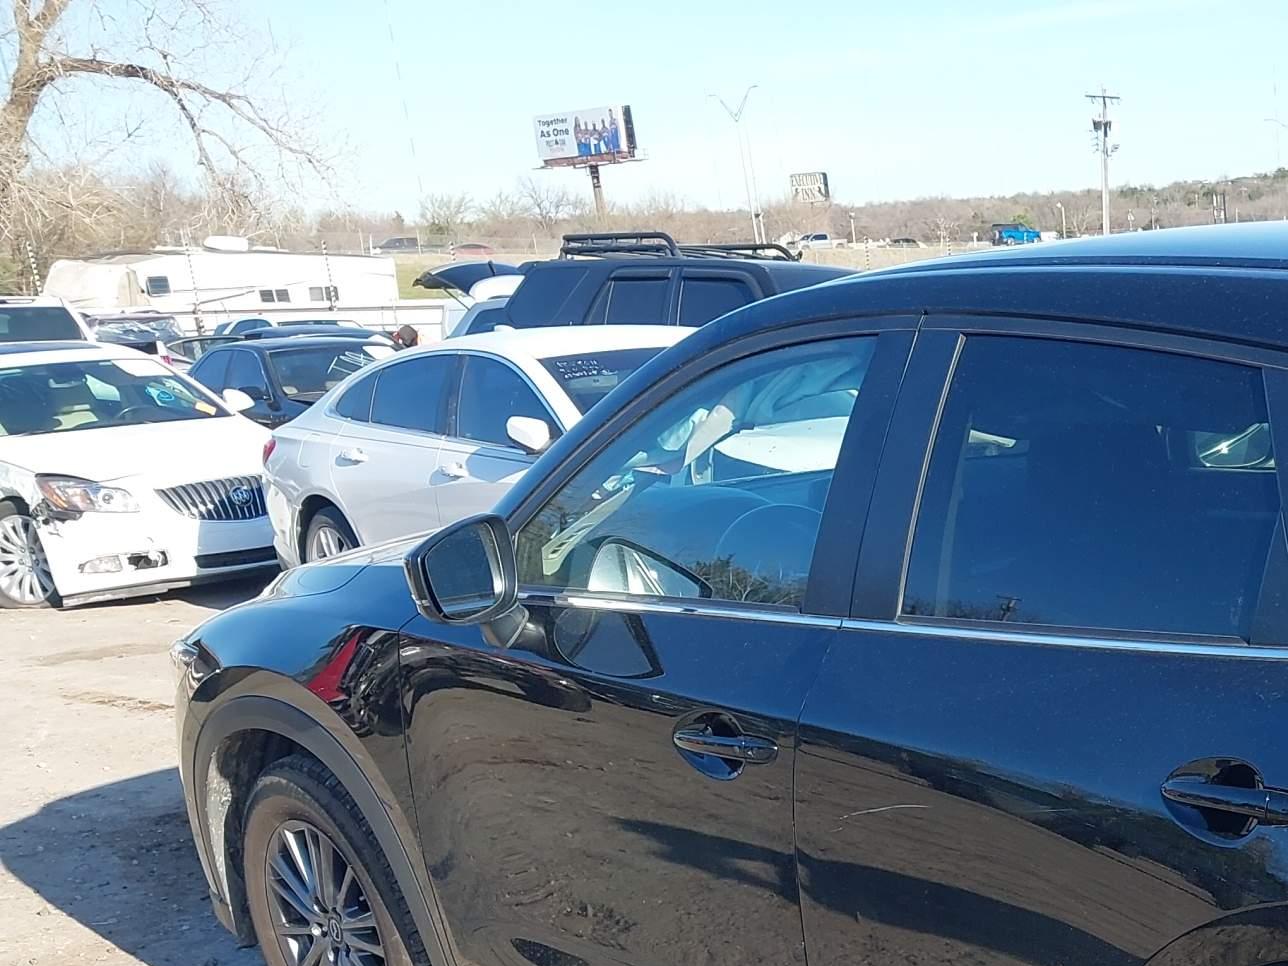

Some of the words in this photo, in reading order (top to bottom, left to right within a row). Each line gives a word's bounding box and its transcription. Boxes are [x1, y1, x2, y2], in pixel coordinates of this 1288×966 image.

[537, 118, 568, 128] Together
[540, 129, 551, 138] As
[552, 128, 569, 137] One
[801, 187, 816, 201] INN
